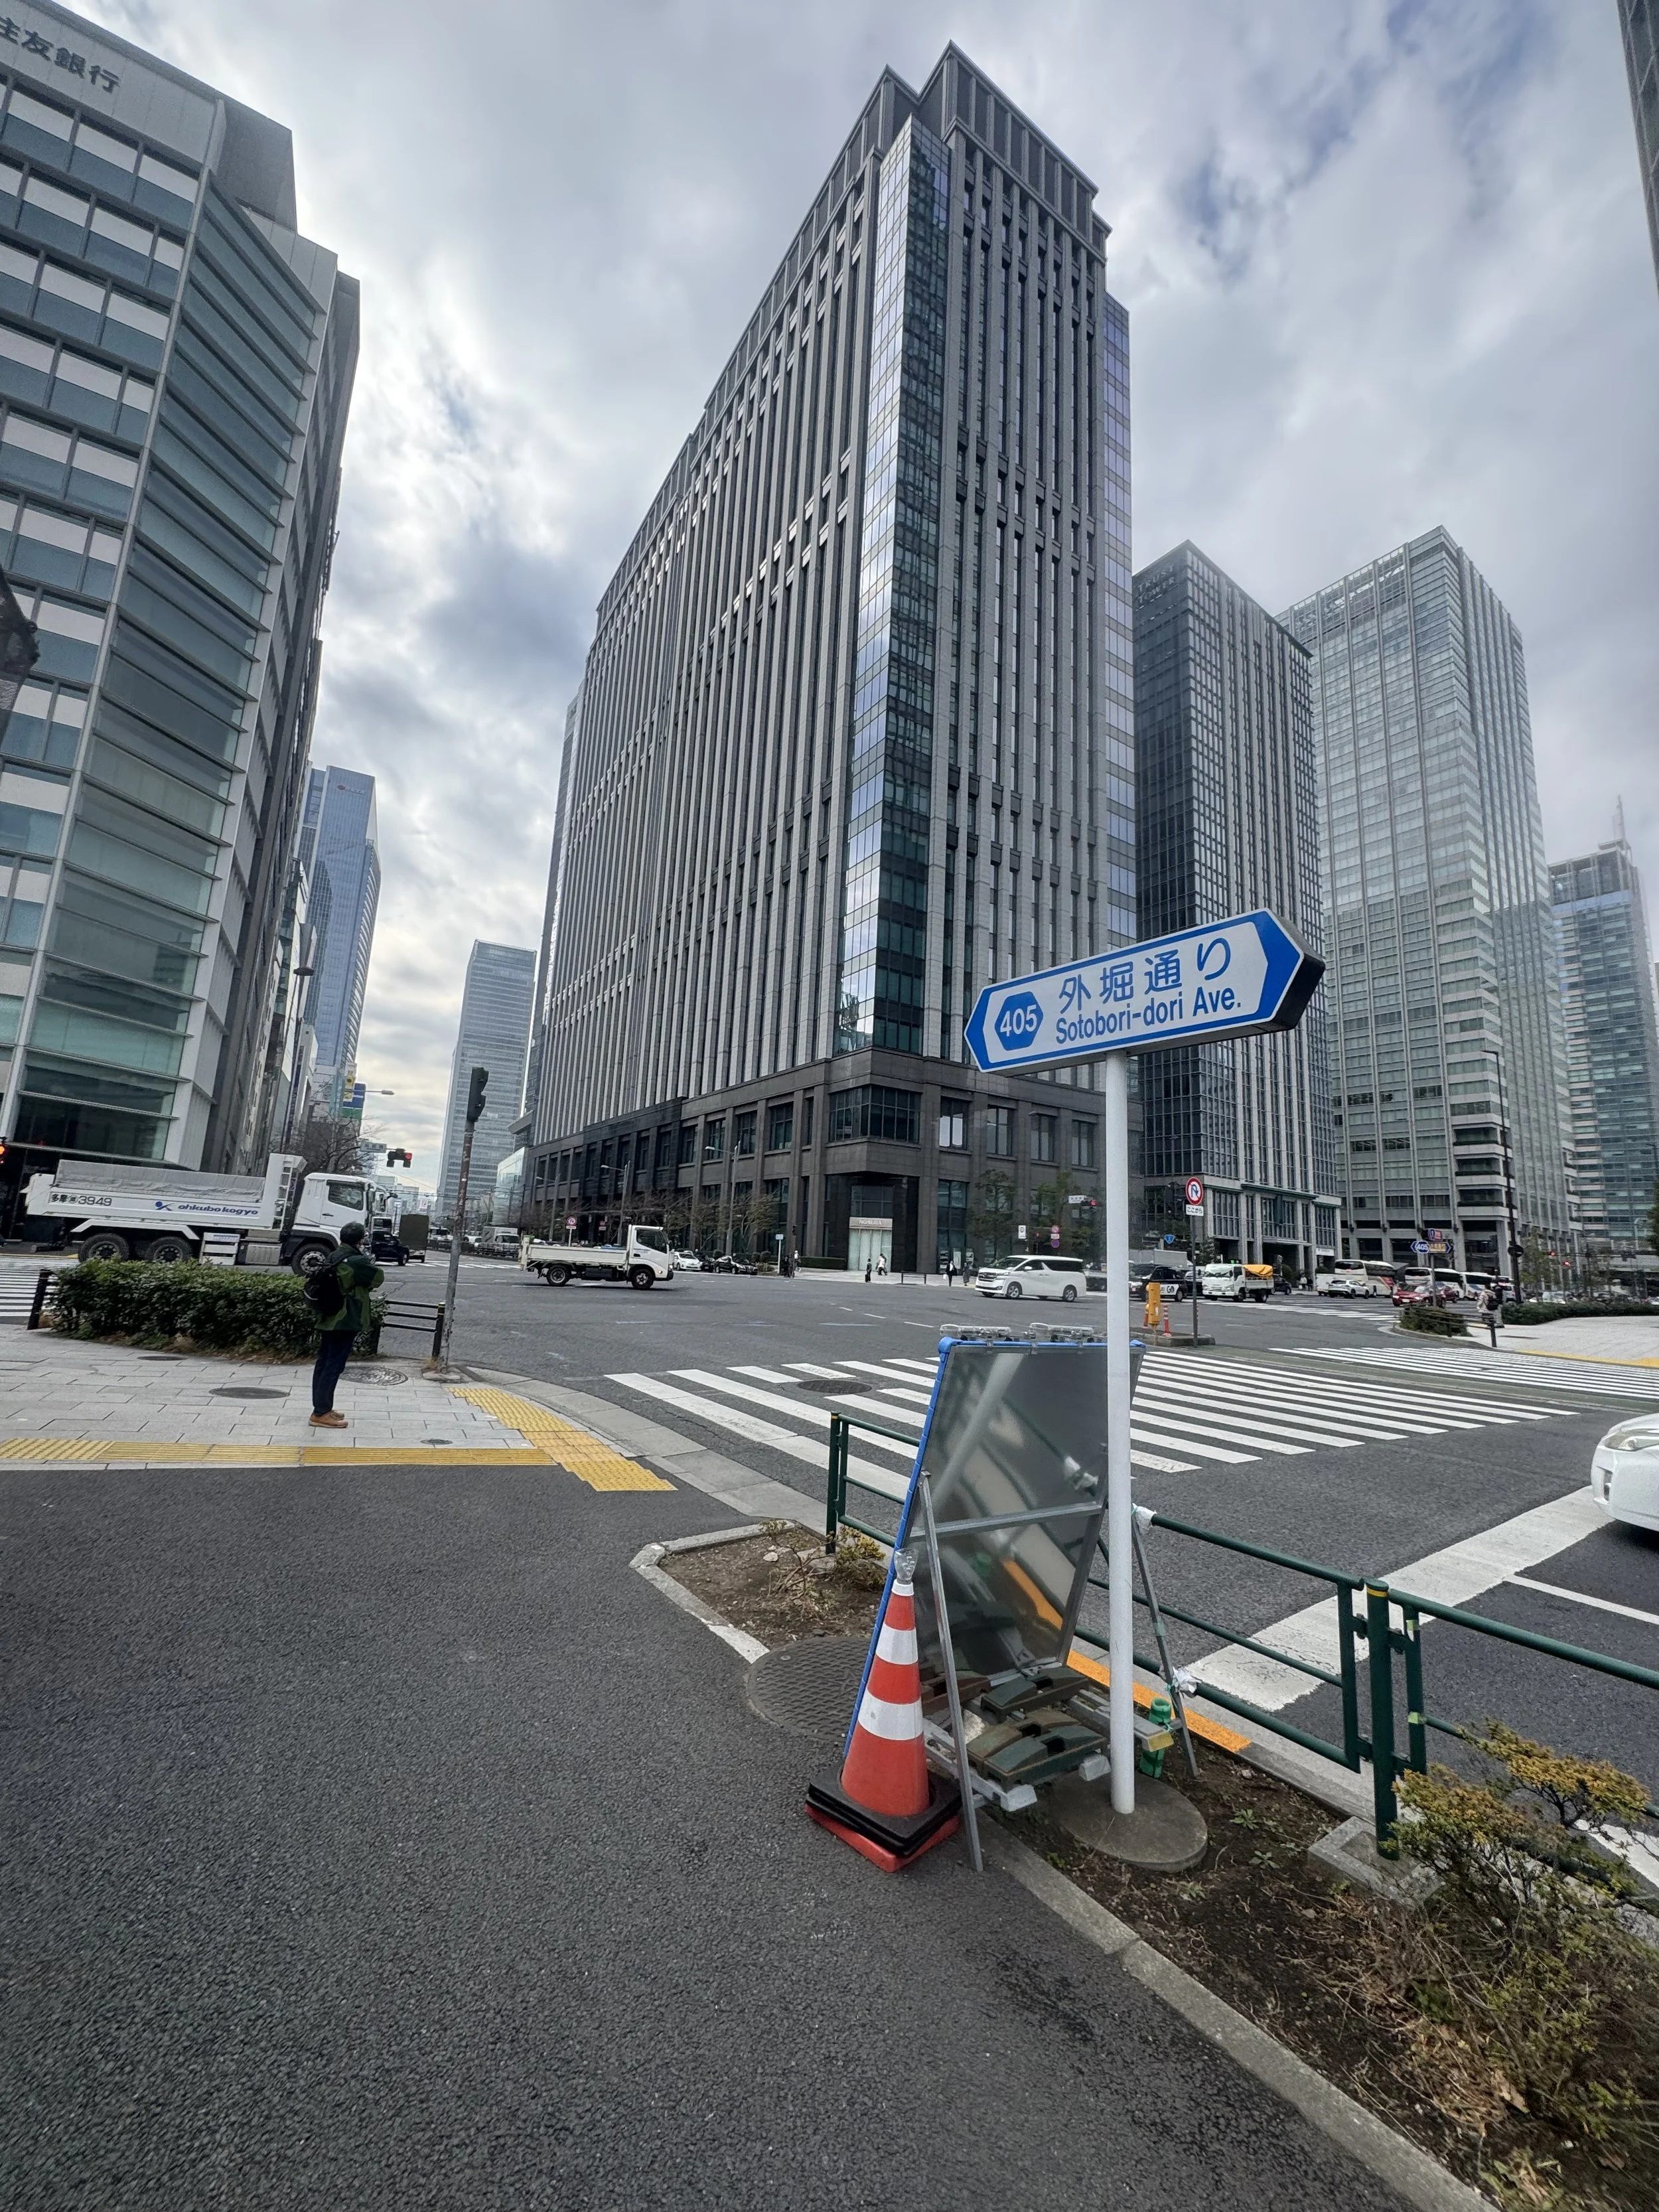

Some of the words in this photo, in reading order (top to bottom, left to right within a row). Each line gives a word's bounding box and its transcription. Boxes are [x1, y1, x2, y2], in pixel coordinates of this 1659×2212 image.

[1137, 563, 1175, 592] TRUST
[1138, 576, 1175, 603] TOWER
[1058, 937, 1231, 1013] 外堀通り
[999, 1004, 1037, 1037] 405
[1056, 992, 1184, 1044] Sotobori-dori
[1193, 986, 1241, 1017] Ave.
